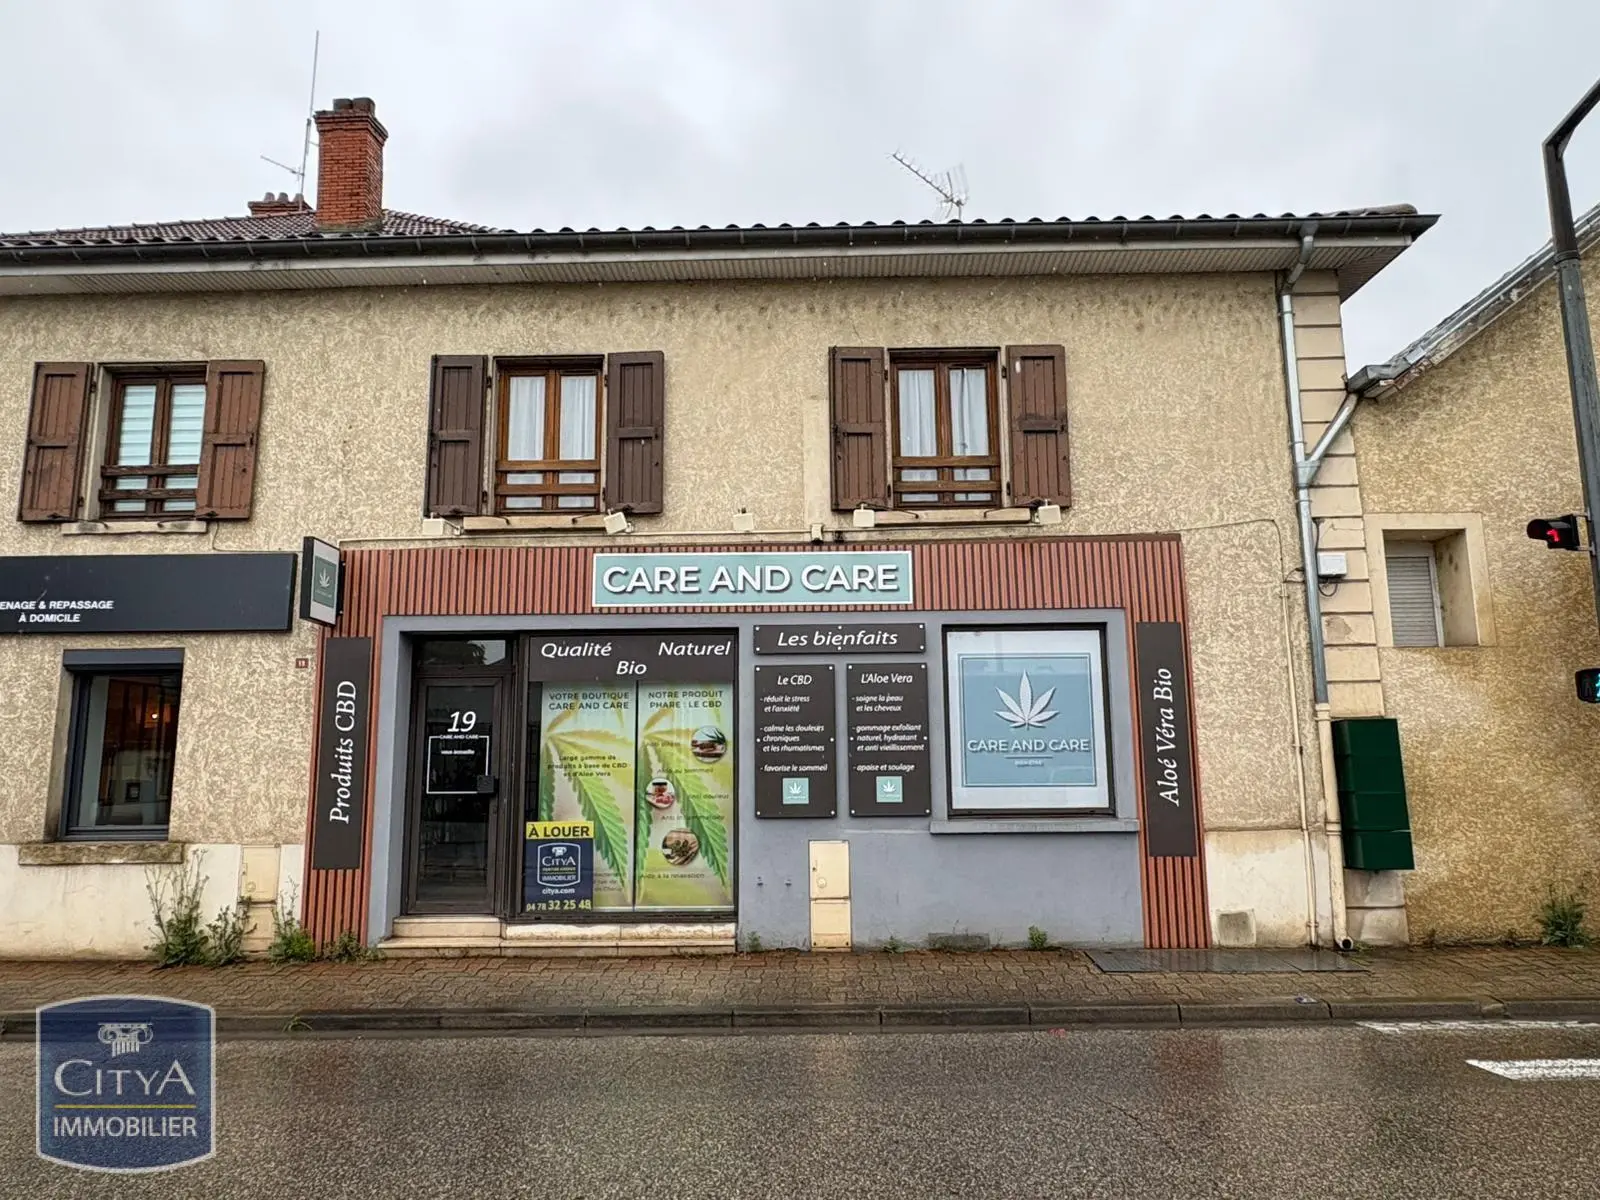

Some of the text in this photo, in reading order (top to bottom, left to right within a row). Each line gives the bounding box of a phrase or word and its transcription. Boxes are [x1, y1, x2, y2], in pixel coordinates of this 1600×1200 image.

[603, 564, 898, 592] CARE AND CARE
[38, 601, 46, 609] &
[49, 601, 114, 609] REPASSAGE
[18, 612, 81, 622] À DOMICILE
[777, 630, 898, 646] Les bienfaits
[541, 641, 731, 658] Qualité Naturel
[616, 660, 647, 675] Bio
[777, 674, 812, 685] Le CBD
[861, 673, 913, 683] L'Aloe Vera
[549, 692, 630, 700] VOTRE BOUTIQUE
[682, 690, 723, 698] PRODUIT
[856, 695, 877, 703] soigne
[549, 701, 630, 710] CARE AND CARE
[650, 701, 681, 709] PHARE
[702, 700, 722, 708] CBD
[447, 710, 476, 732] 19
[763, 724, 784, 732] calme
[856, 724, 891, 733] gommage
[763, 734, 800, 743] chroniques
[883, 734, 917, 742] hydratant
[1153, 668, 1179, 807] Aloé Véra Bio
[771, 744, 780, 752] les
[967, 739, 1090, 751] CARE AND CARE
[329, 681, 357, 825] Produits CBD
[764, 764, 791, 772] favorise
[528, 824, 590, 837] À LOUER
[542, 856, 576, 866] CITYA
[548, 899, 560, 910] 32
[563, 899, 576, 910] 25
